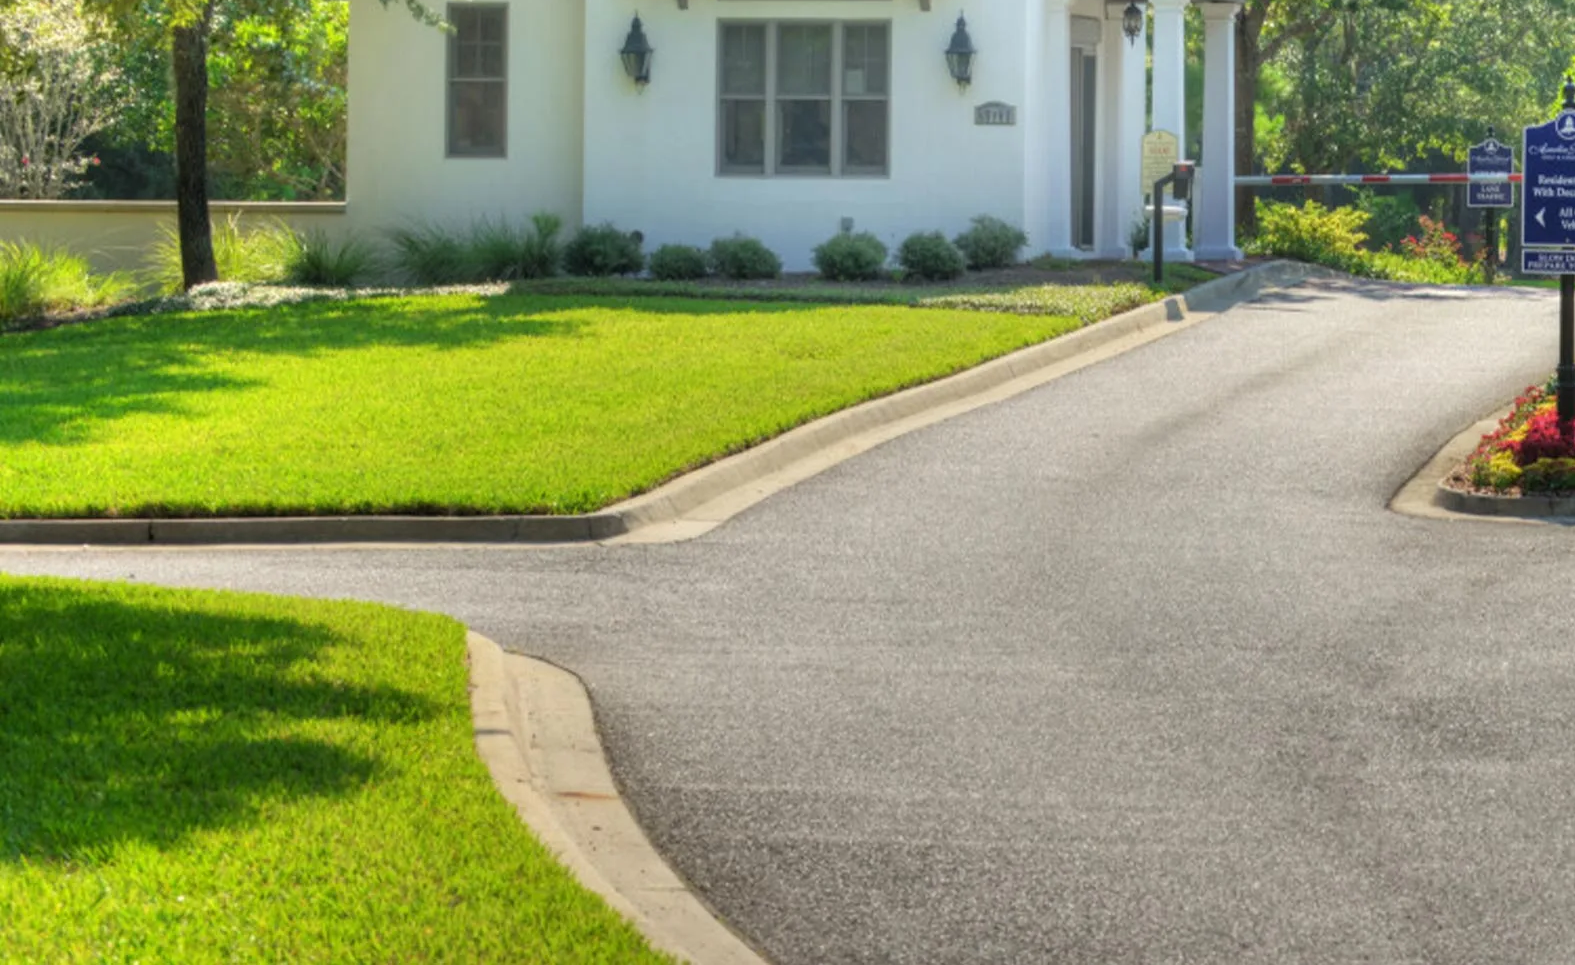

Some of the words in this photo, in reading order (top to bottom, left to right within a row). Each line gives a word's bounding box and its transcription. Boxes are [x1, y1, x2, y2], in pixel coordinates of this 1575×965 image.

[1533, 186, 1555, 197] With
[1559, 207, 1573, 217] All
[1538, 253, 1564, 263] SLOW
[1527, 261, 1565, 270] PREPARE
